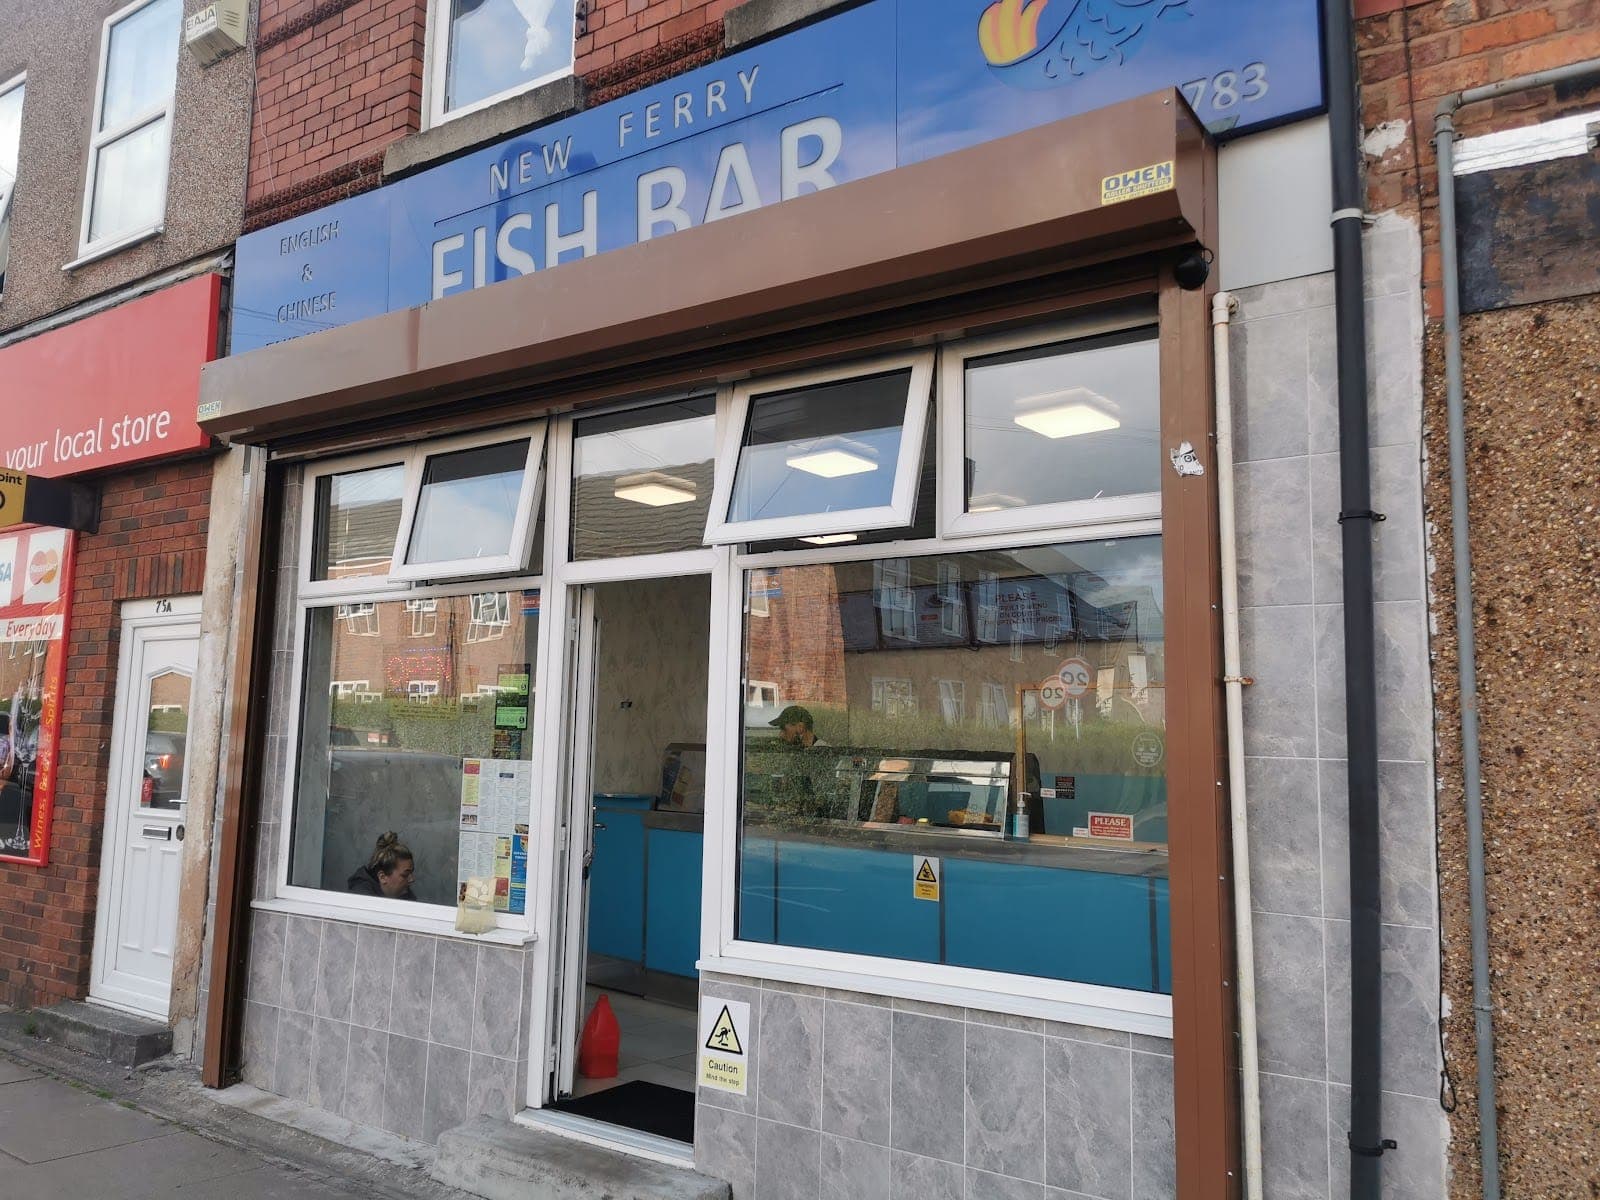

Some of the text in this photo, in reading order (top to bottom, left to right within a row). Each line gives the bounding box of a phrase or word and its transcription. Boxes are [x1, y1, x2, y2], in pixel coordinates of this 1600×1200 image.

[1182, 60, 1269, 113] 783
[489, 65, 760, 195] NEW FERRY
[1105, 162, 1171, 191] OWEN
[432, 115, 842, 300] FISH BAR
[279, 220, 340, 256] ENGLISH
[301, 263, 313, 282] &
[277, 291, 337, 323] CHINESE
[6, 410, 171, 471] your local store
[6, 617, 56, 640] Everyday
[1094, 816, 1127, 826] PLEASE
[708, 1060, 738, 1074] Caution
